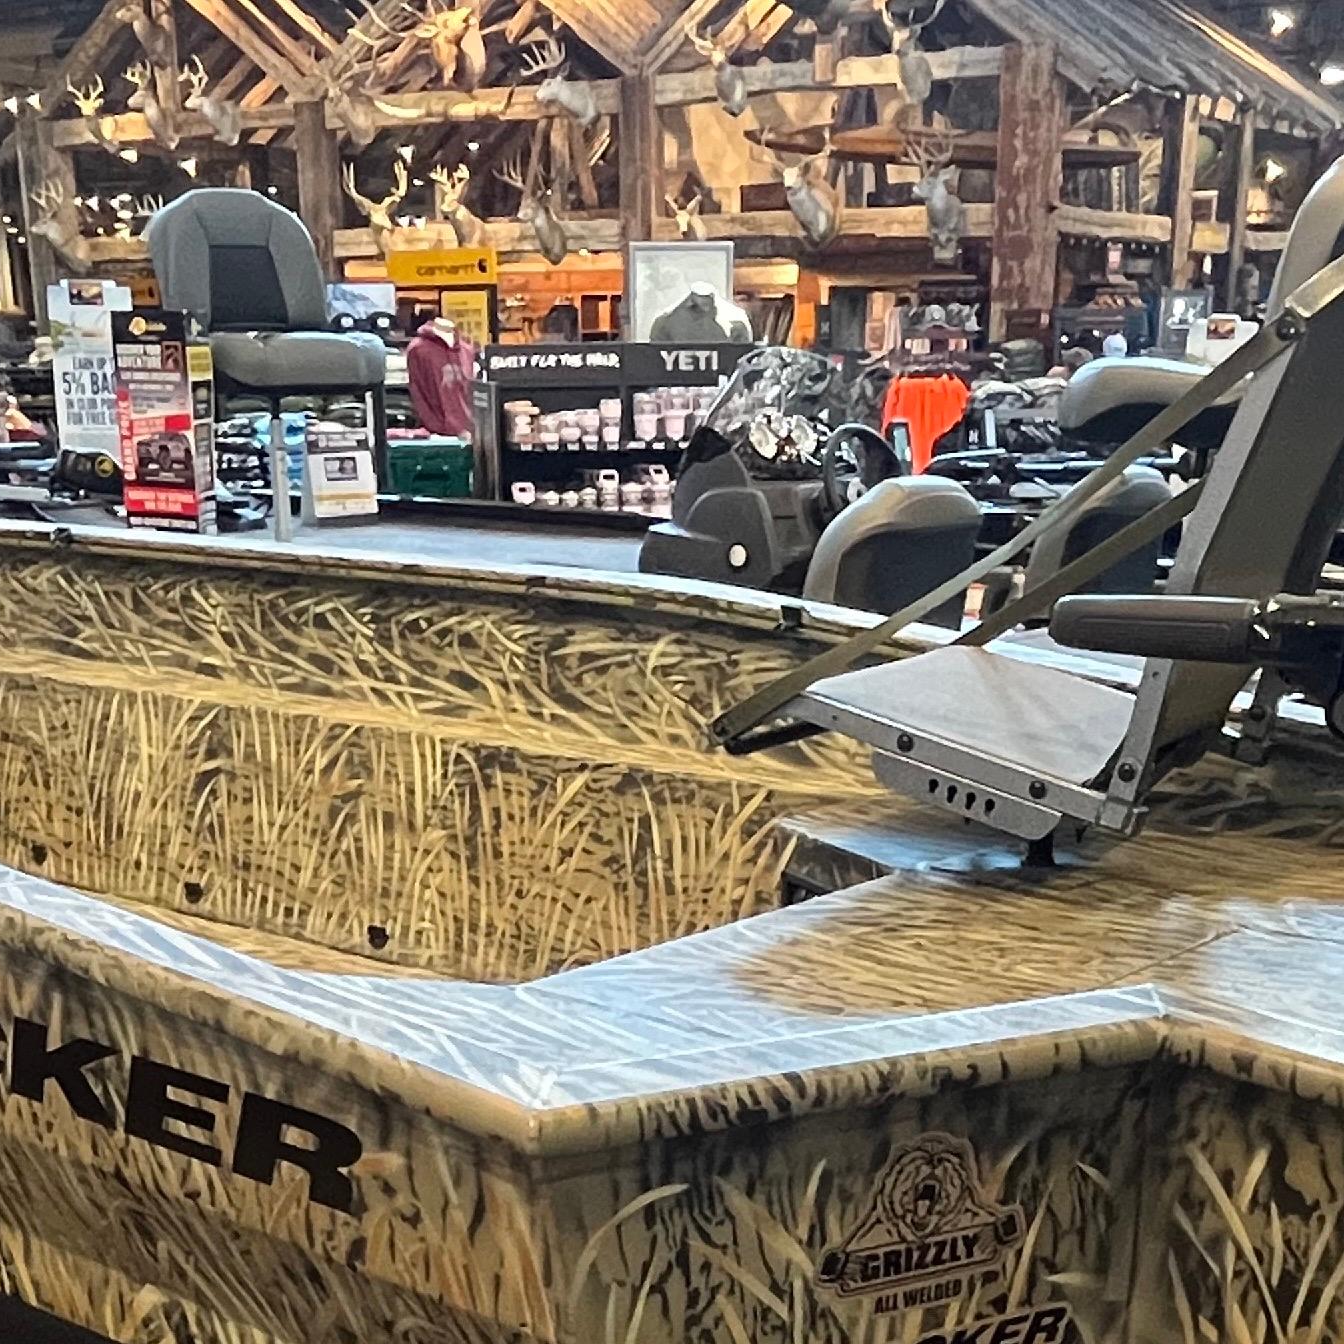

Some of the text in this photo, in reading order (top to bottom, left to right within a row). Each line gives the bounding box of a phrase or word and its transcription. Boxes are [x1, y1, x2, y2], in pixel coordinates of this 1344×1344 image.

[661, 350, 719, 371] YETI
[62, 371, 86, 396] 5%
[860, 1235, 979, 1284] GRIZZLY
[875, 1278, 963, 1315] ALL WELDED
